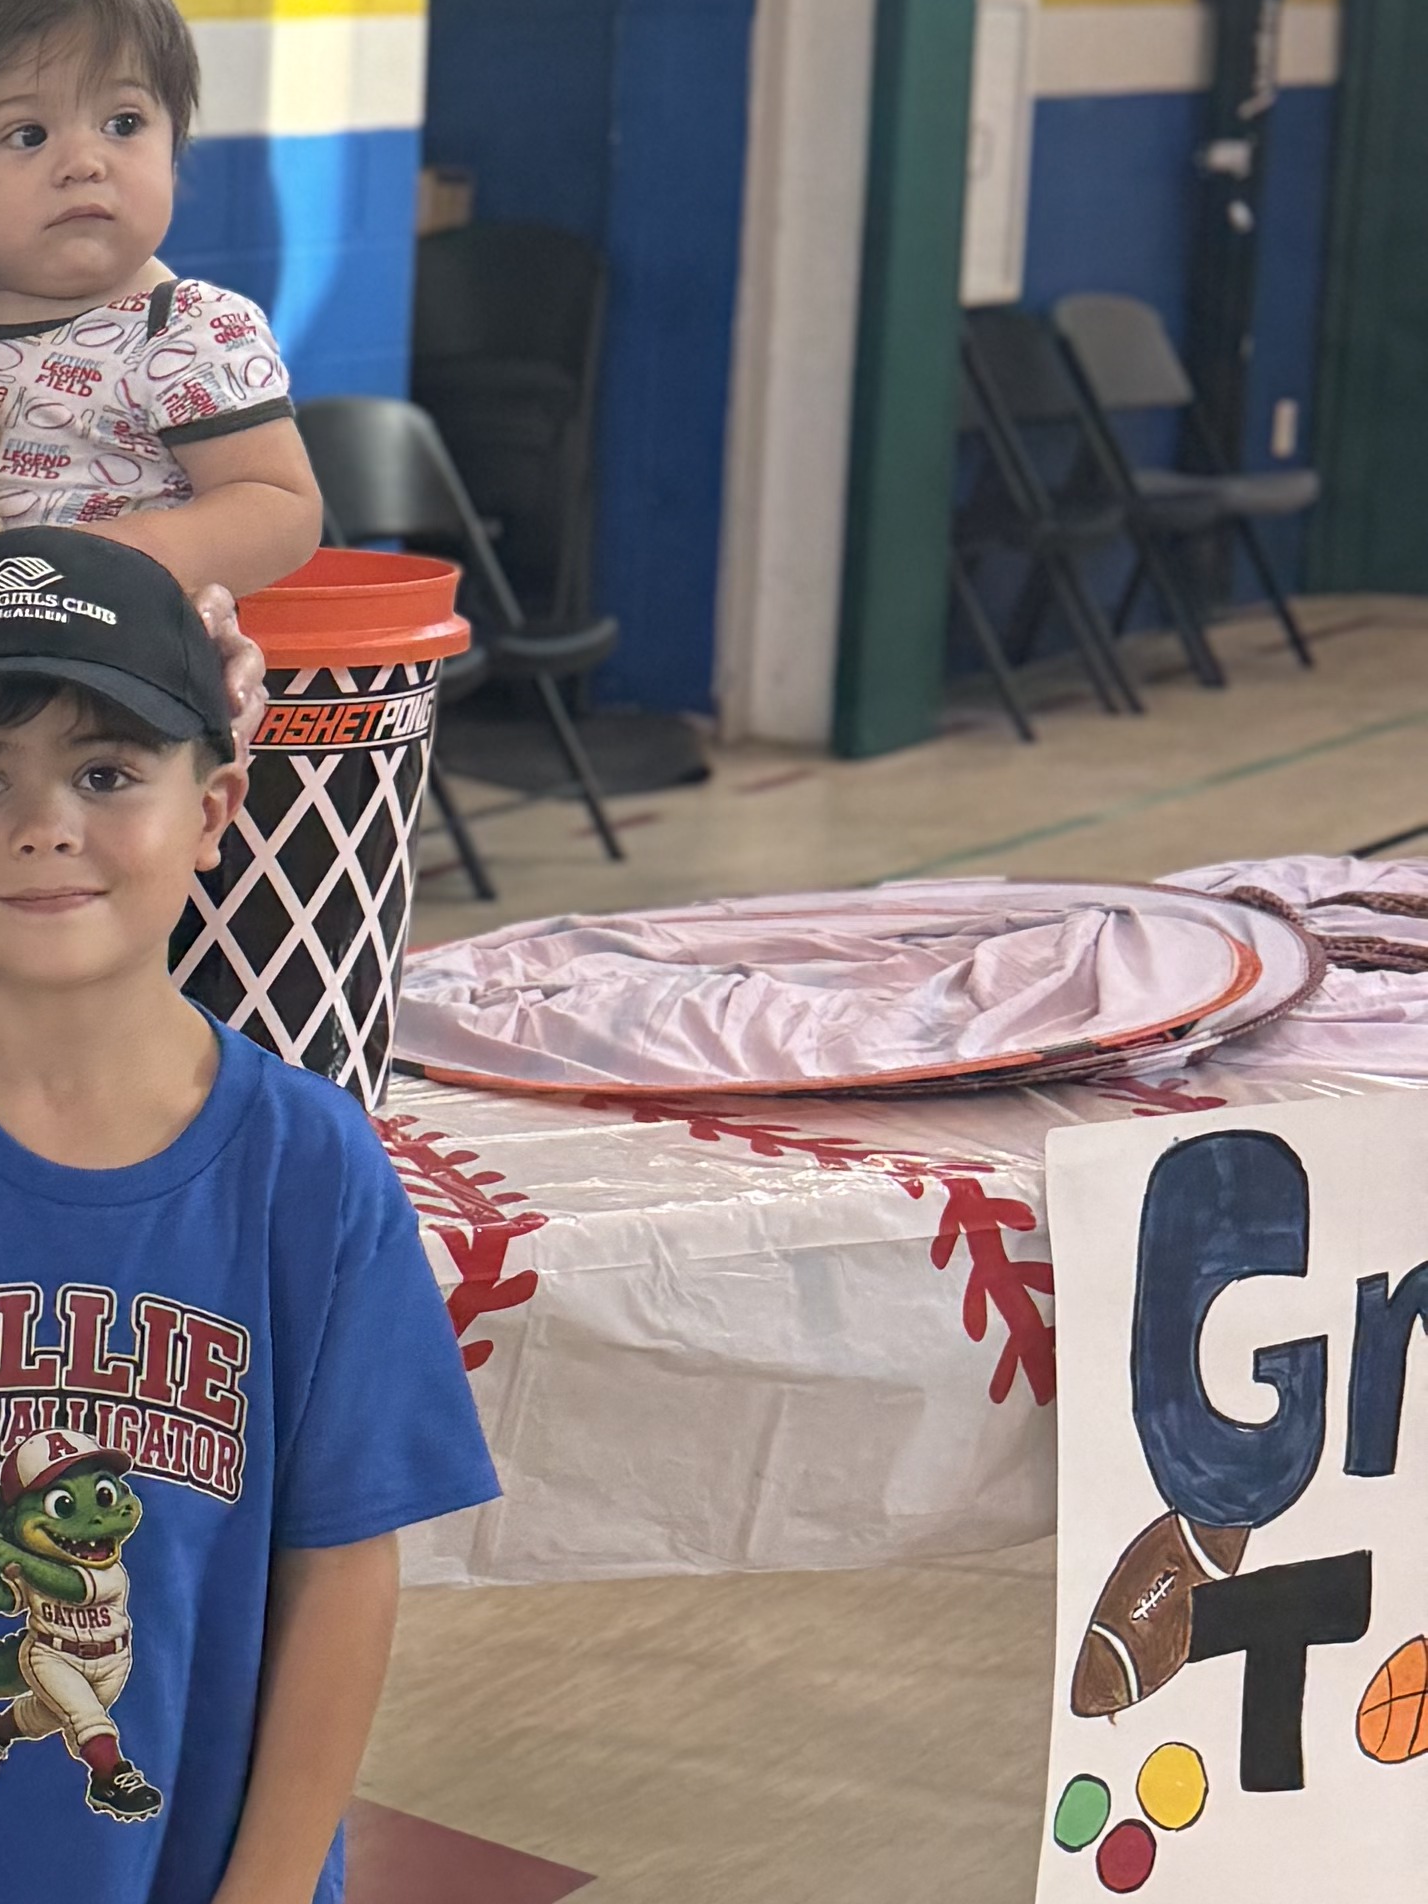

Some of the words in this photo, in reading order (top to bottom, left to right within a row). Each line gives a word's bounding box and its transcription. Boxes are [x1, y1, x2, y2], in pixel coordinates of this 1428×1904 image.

[41, 359, 103, 383] LEGEND
[35, 372, 93, 398] FIELD
[1, 448, 71, 468] LEGEND
[62, 597, 118, 626] CLUB
[253, 689, 434, 744] ASKETPONG
[44, 1431, 80, 1462] A
[40, 1603, 112, 1630] GATORS
